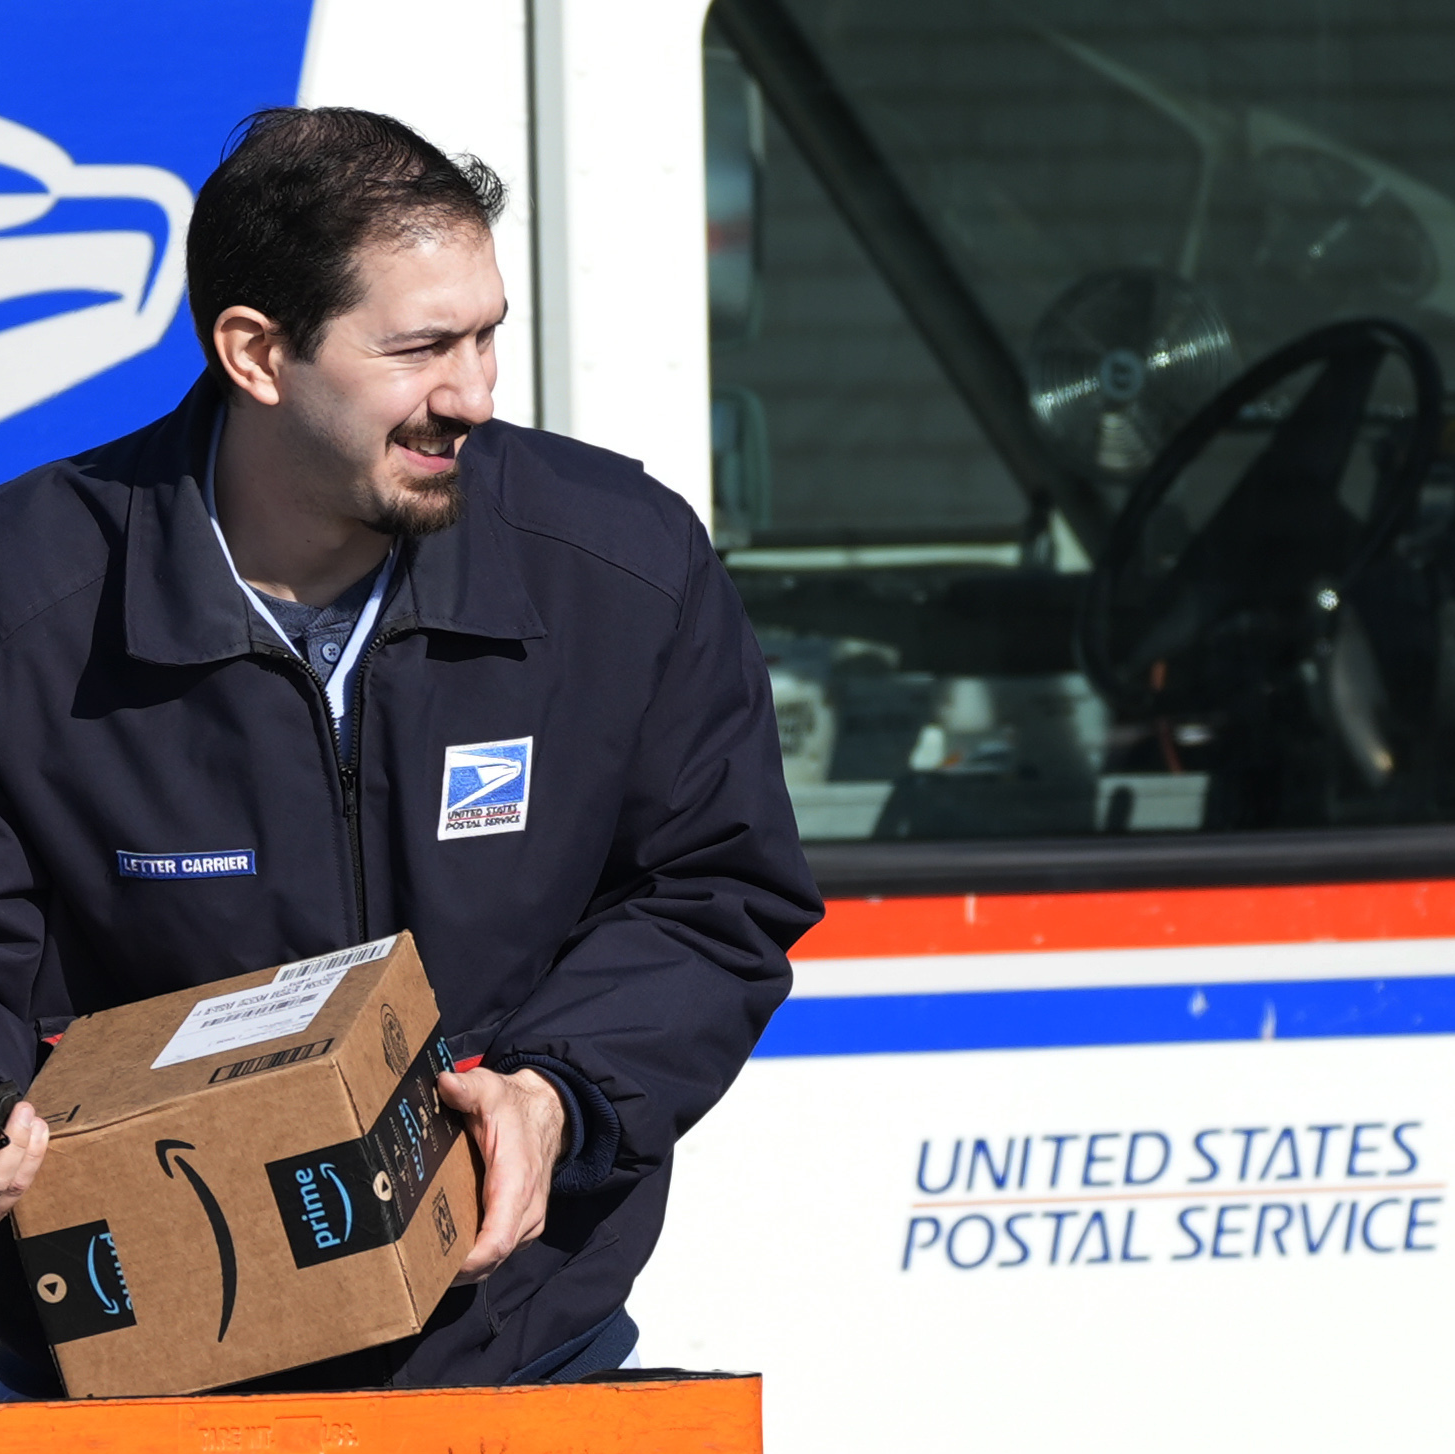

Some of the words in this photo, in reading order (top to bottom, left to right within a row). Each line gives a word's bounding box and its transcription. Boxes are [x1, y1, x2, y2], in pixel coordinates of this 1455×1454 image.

[445, 819, 482, 832] POSTAL
[447, 808, 483, 820] UNITED
[123, 858, 176, 874] LETTER
[181, 855, 249, 873] CARRIER
[915, 1131, 1172, 1195] UNITED
[1186, 1121, 1423, 1184] STATES
[295, 1167, 342, 1249] prime
[900, 1208, 1151, 1272] POSTAL
[1170, 1195, 1444, 1261] SERVICE
